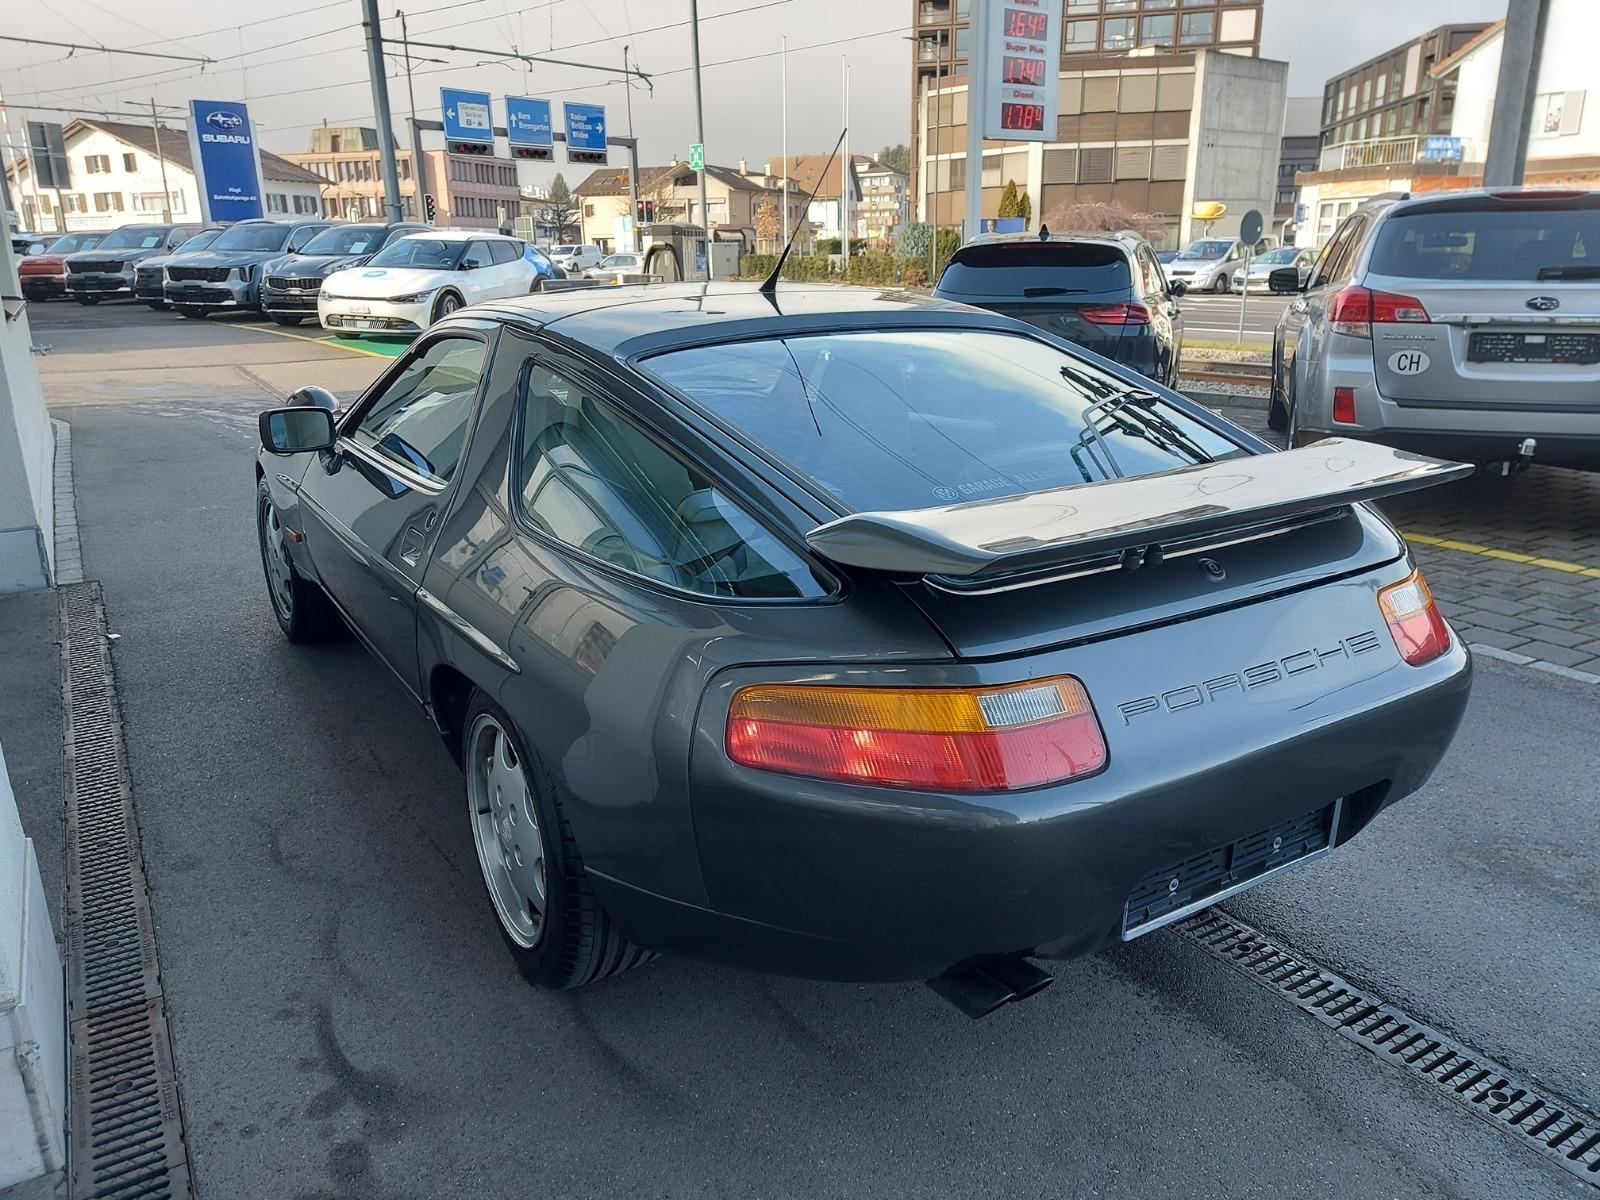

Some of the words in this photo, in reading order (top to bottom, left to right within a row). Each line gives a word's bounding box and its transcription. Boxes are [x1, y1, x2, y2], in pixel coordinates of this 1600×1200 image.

[1006, 42, 1027, 52] Super
[1029, 44, 1044, 54] Plus
[1013, 90, 1034, 99] Diesel
[518, 111, 531, 121] Bern
[570, 113, 587, 121] Baden
[519, 121, 549, 131] Bremgarten
[202, 134, 250, 144] SUBARU
[572, 131, 588, 139] Widen
[1397, 353, 1422, 372] CH
[958, 477, 1012, 495] GARAGE
[1117, 630, 1382, 727] PORSCHE
